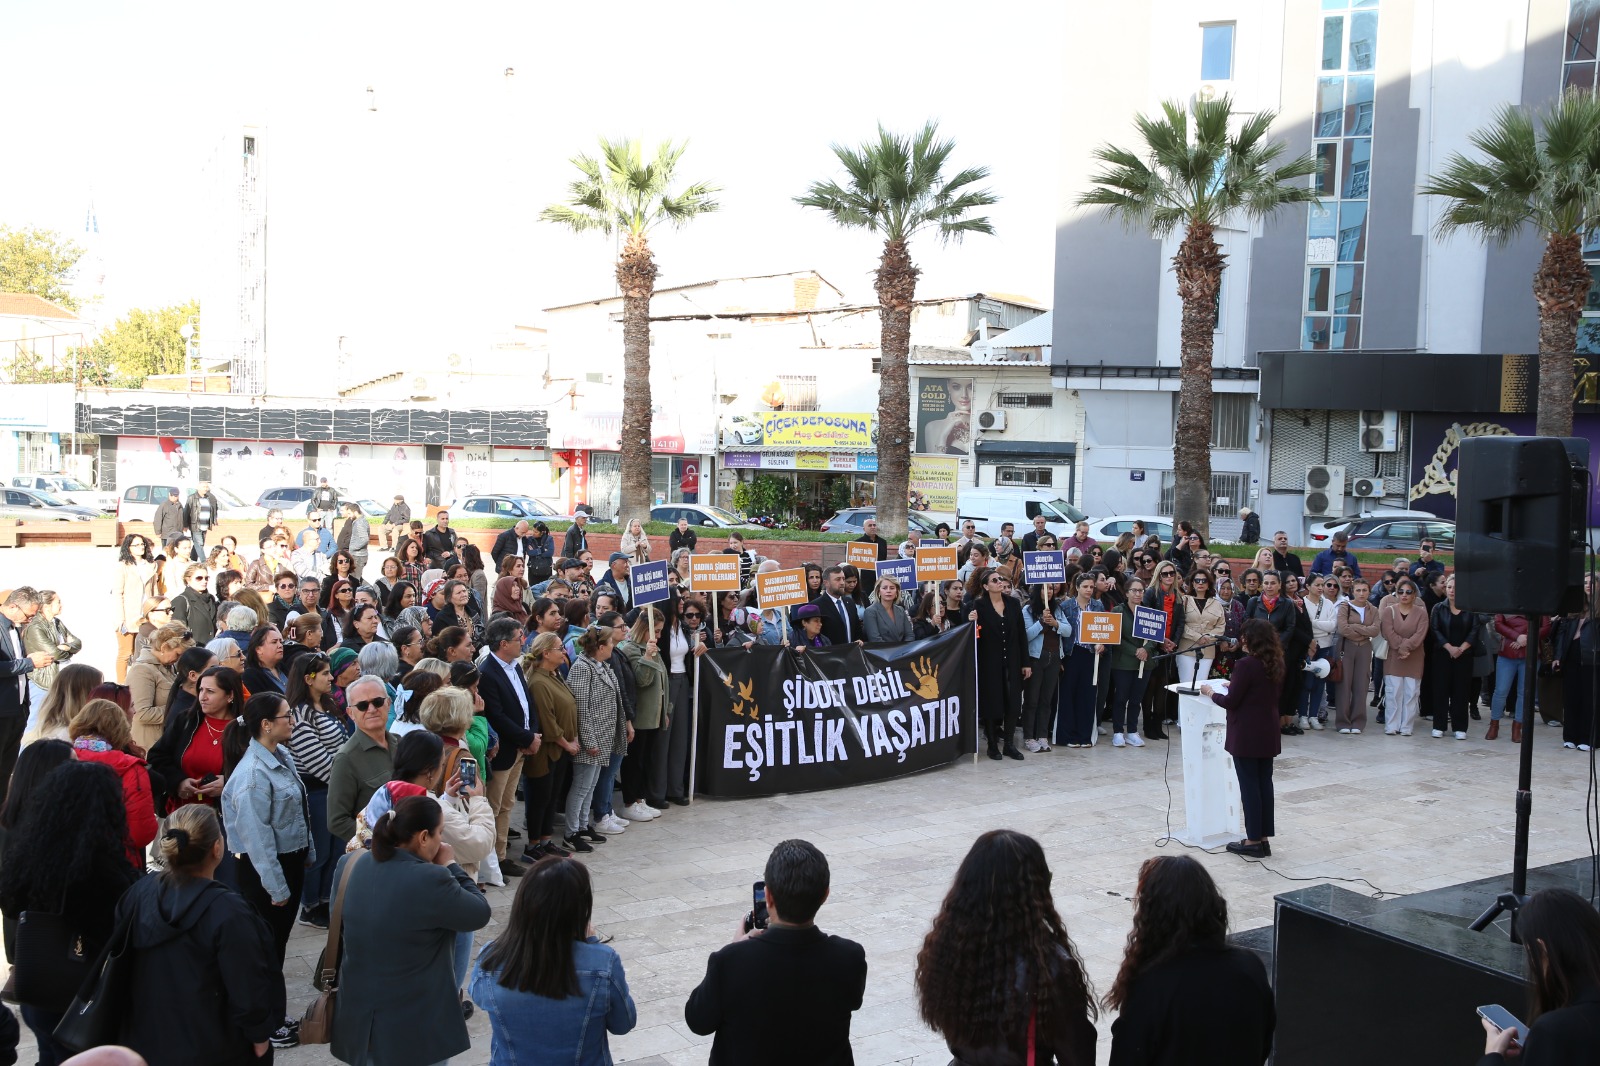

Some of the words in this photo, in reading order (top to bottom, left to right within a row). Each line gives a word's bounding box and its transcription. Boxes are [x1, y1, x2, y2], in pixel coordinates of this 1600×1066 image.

[766, 414, 800, 438] ÇİÇEK
[801, 416, 867, 436] DEPOSUNA
[794, 431, 812, 440] Hoş
[814, 431, 849, 439] Geldiniz
[466, 466, 487, 479] Depo
[910, 481, 954, 490] KAMPANYA
[937, 556, 951, 564] ŞİDDET
[715, 562, 736, 571] ŞİDDETE
[896, 565, 912, 574] ŞİDDETİ
[653, 570, 663, 579] DAHA
[765, 575, 798, 585] SUSMUYORUZ
[761, 595, 774, 603] İTAAT
[1094, 615, 1109, 624] ŞİDDET
[782, 674, 846, 718] ŞİDDET
[852, 666, 911, 706] DEĞİL
[723, 712, 849, 781] EŞİTLİK
[851, 696, 960, 763] YAŞATIR
